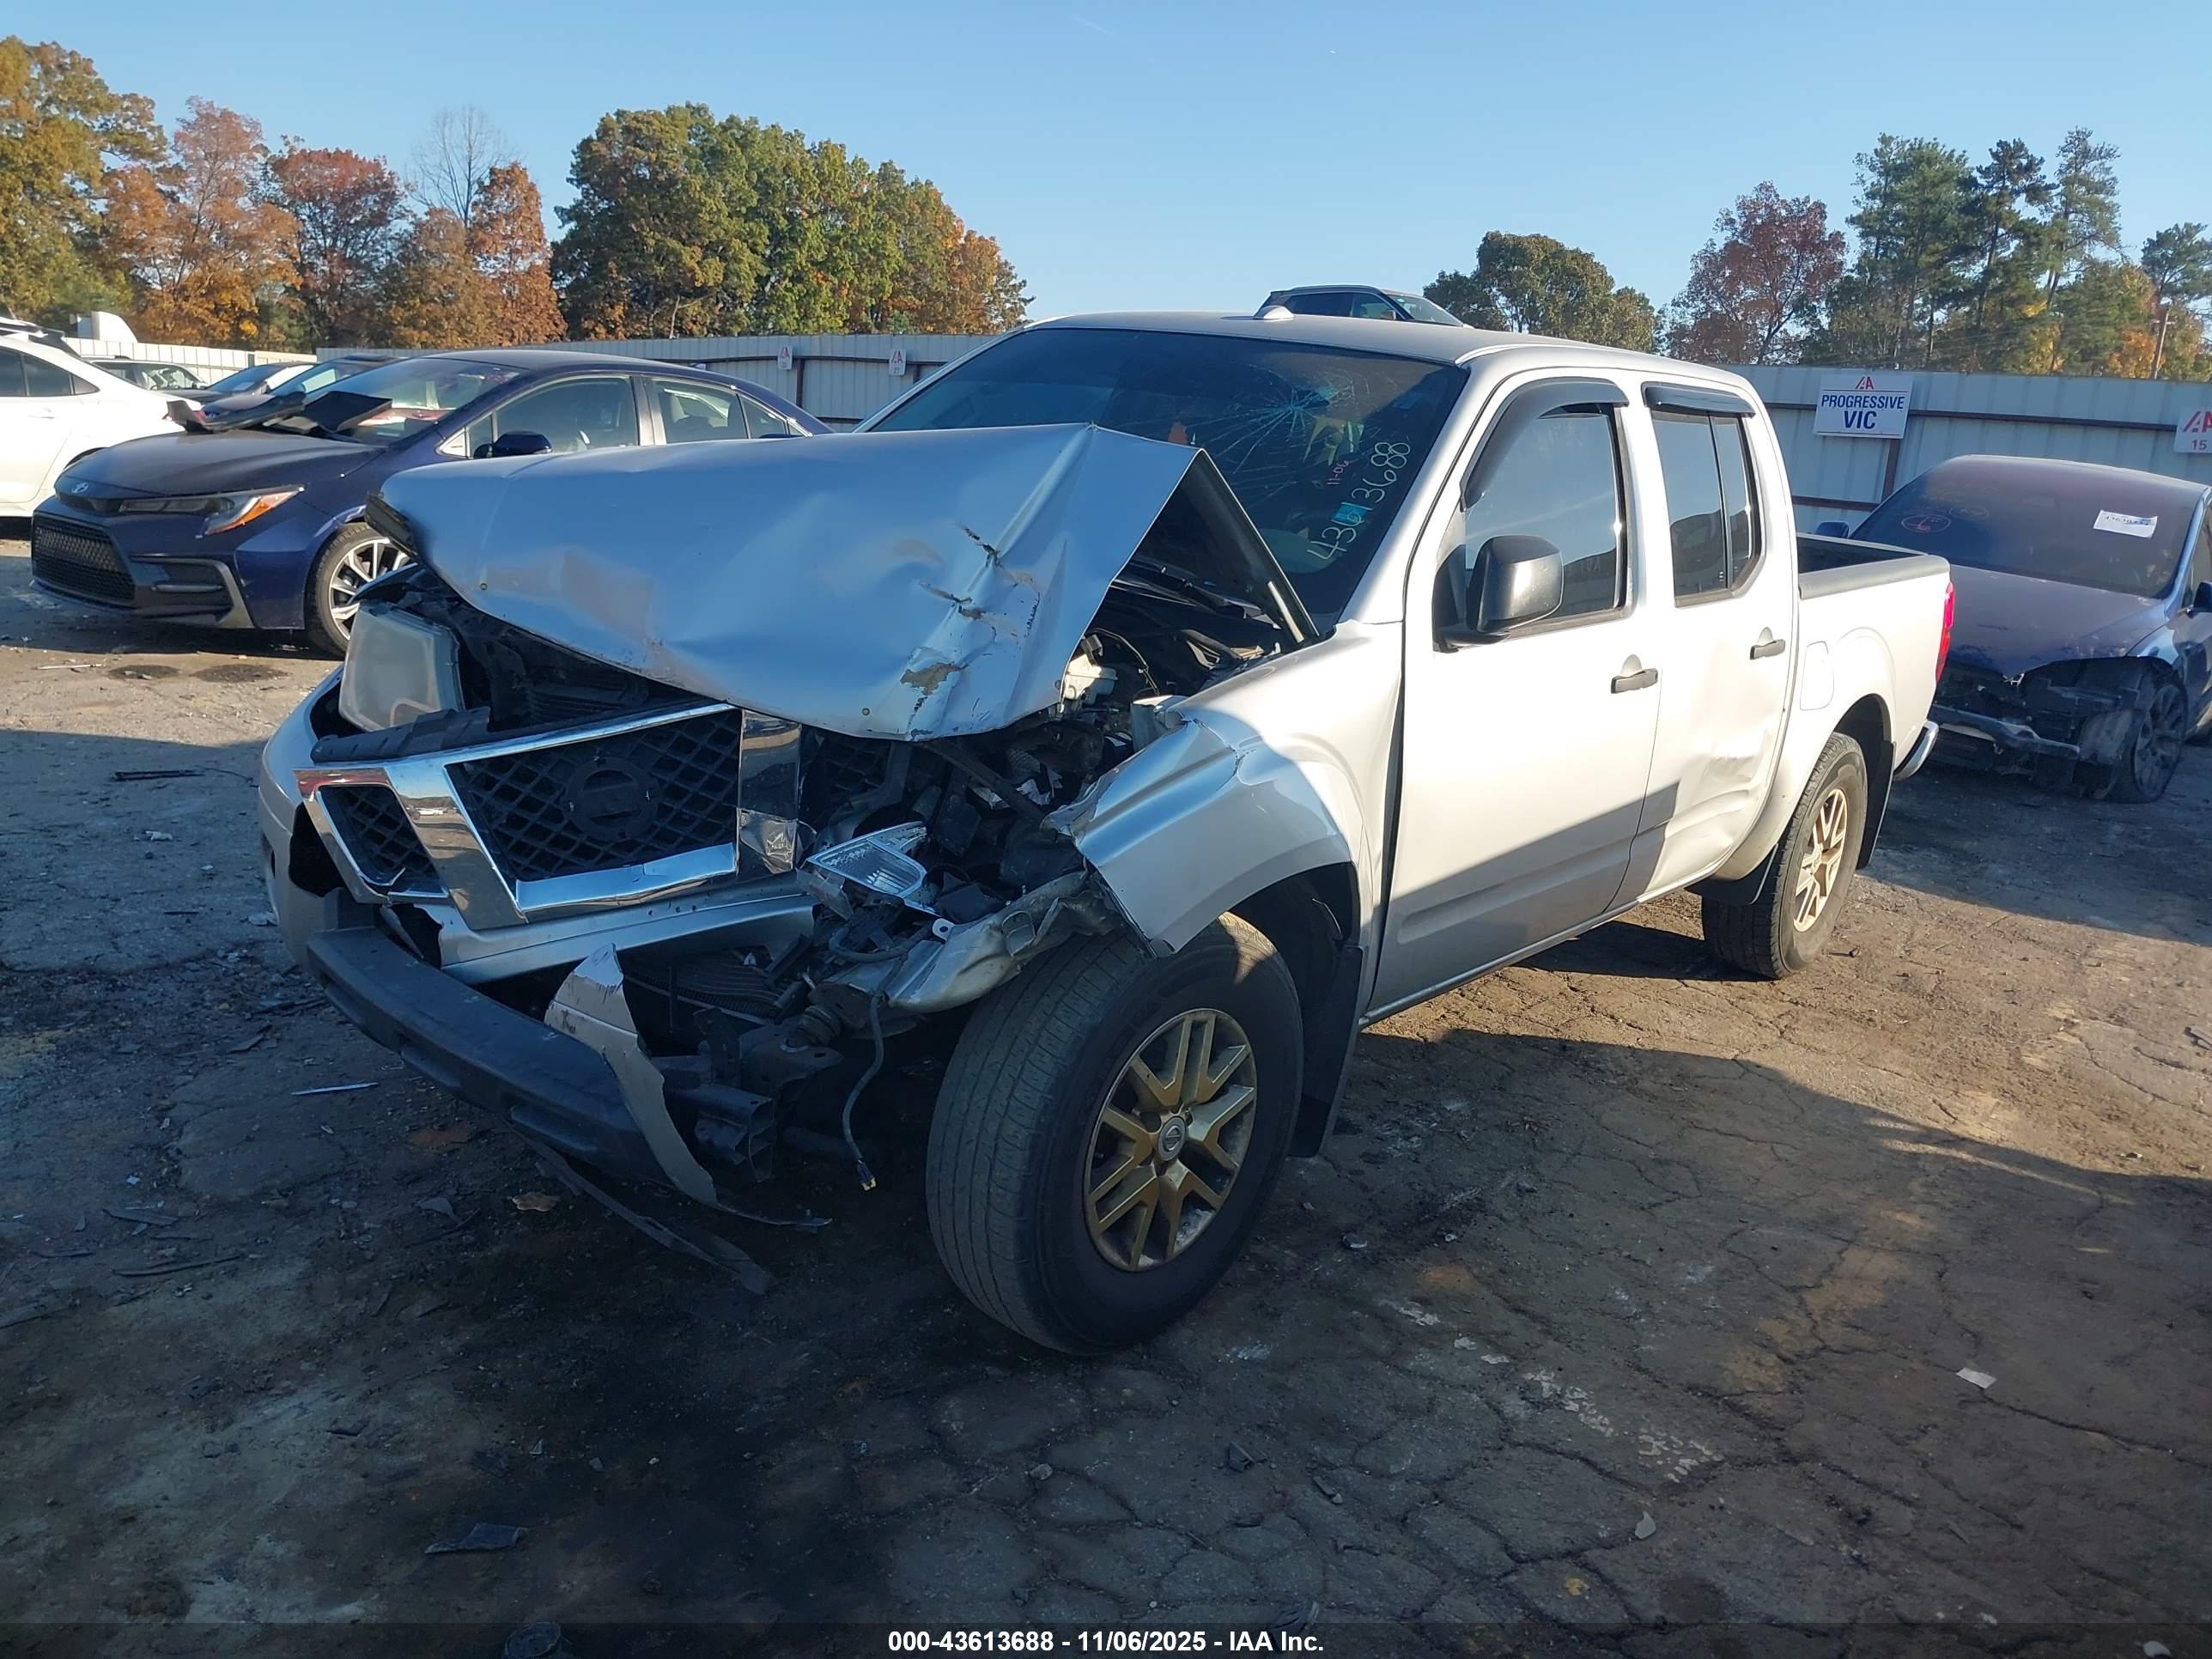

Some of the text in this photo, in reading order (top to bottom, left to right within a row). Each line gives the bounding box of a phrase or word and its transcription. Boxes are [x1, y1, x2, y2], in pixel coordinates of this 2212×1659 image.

[1820, 394, 1905, 410] PROGRESSIVE
[1844, 410, 1877, 429] VIC
[2191, 439, 2208, 451] 15
[1326, 459, 1351, 486] 11-06
[1306, 441, 1411, 560] 43613688
